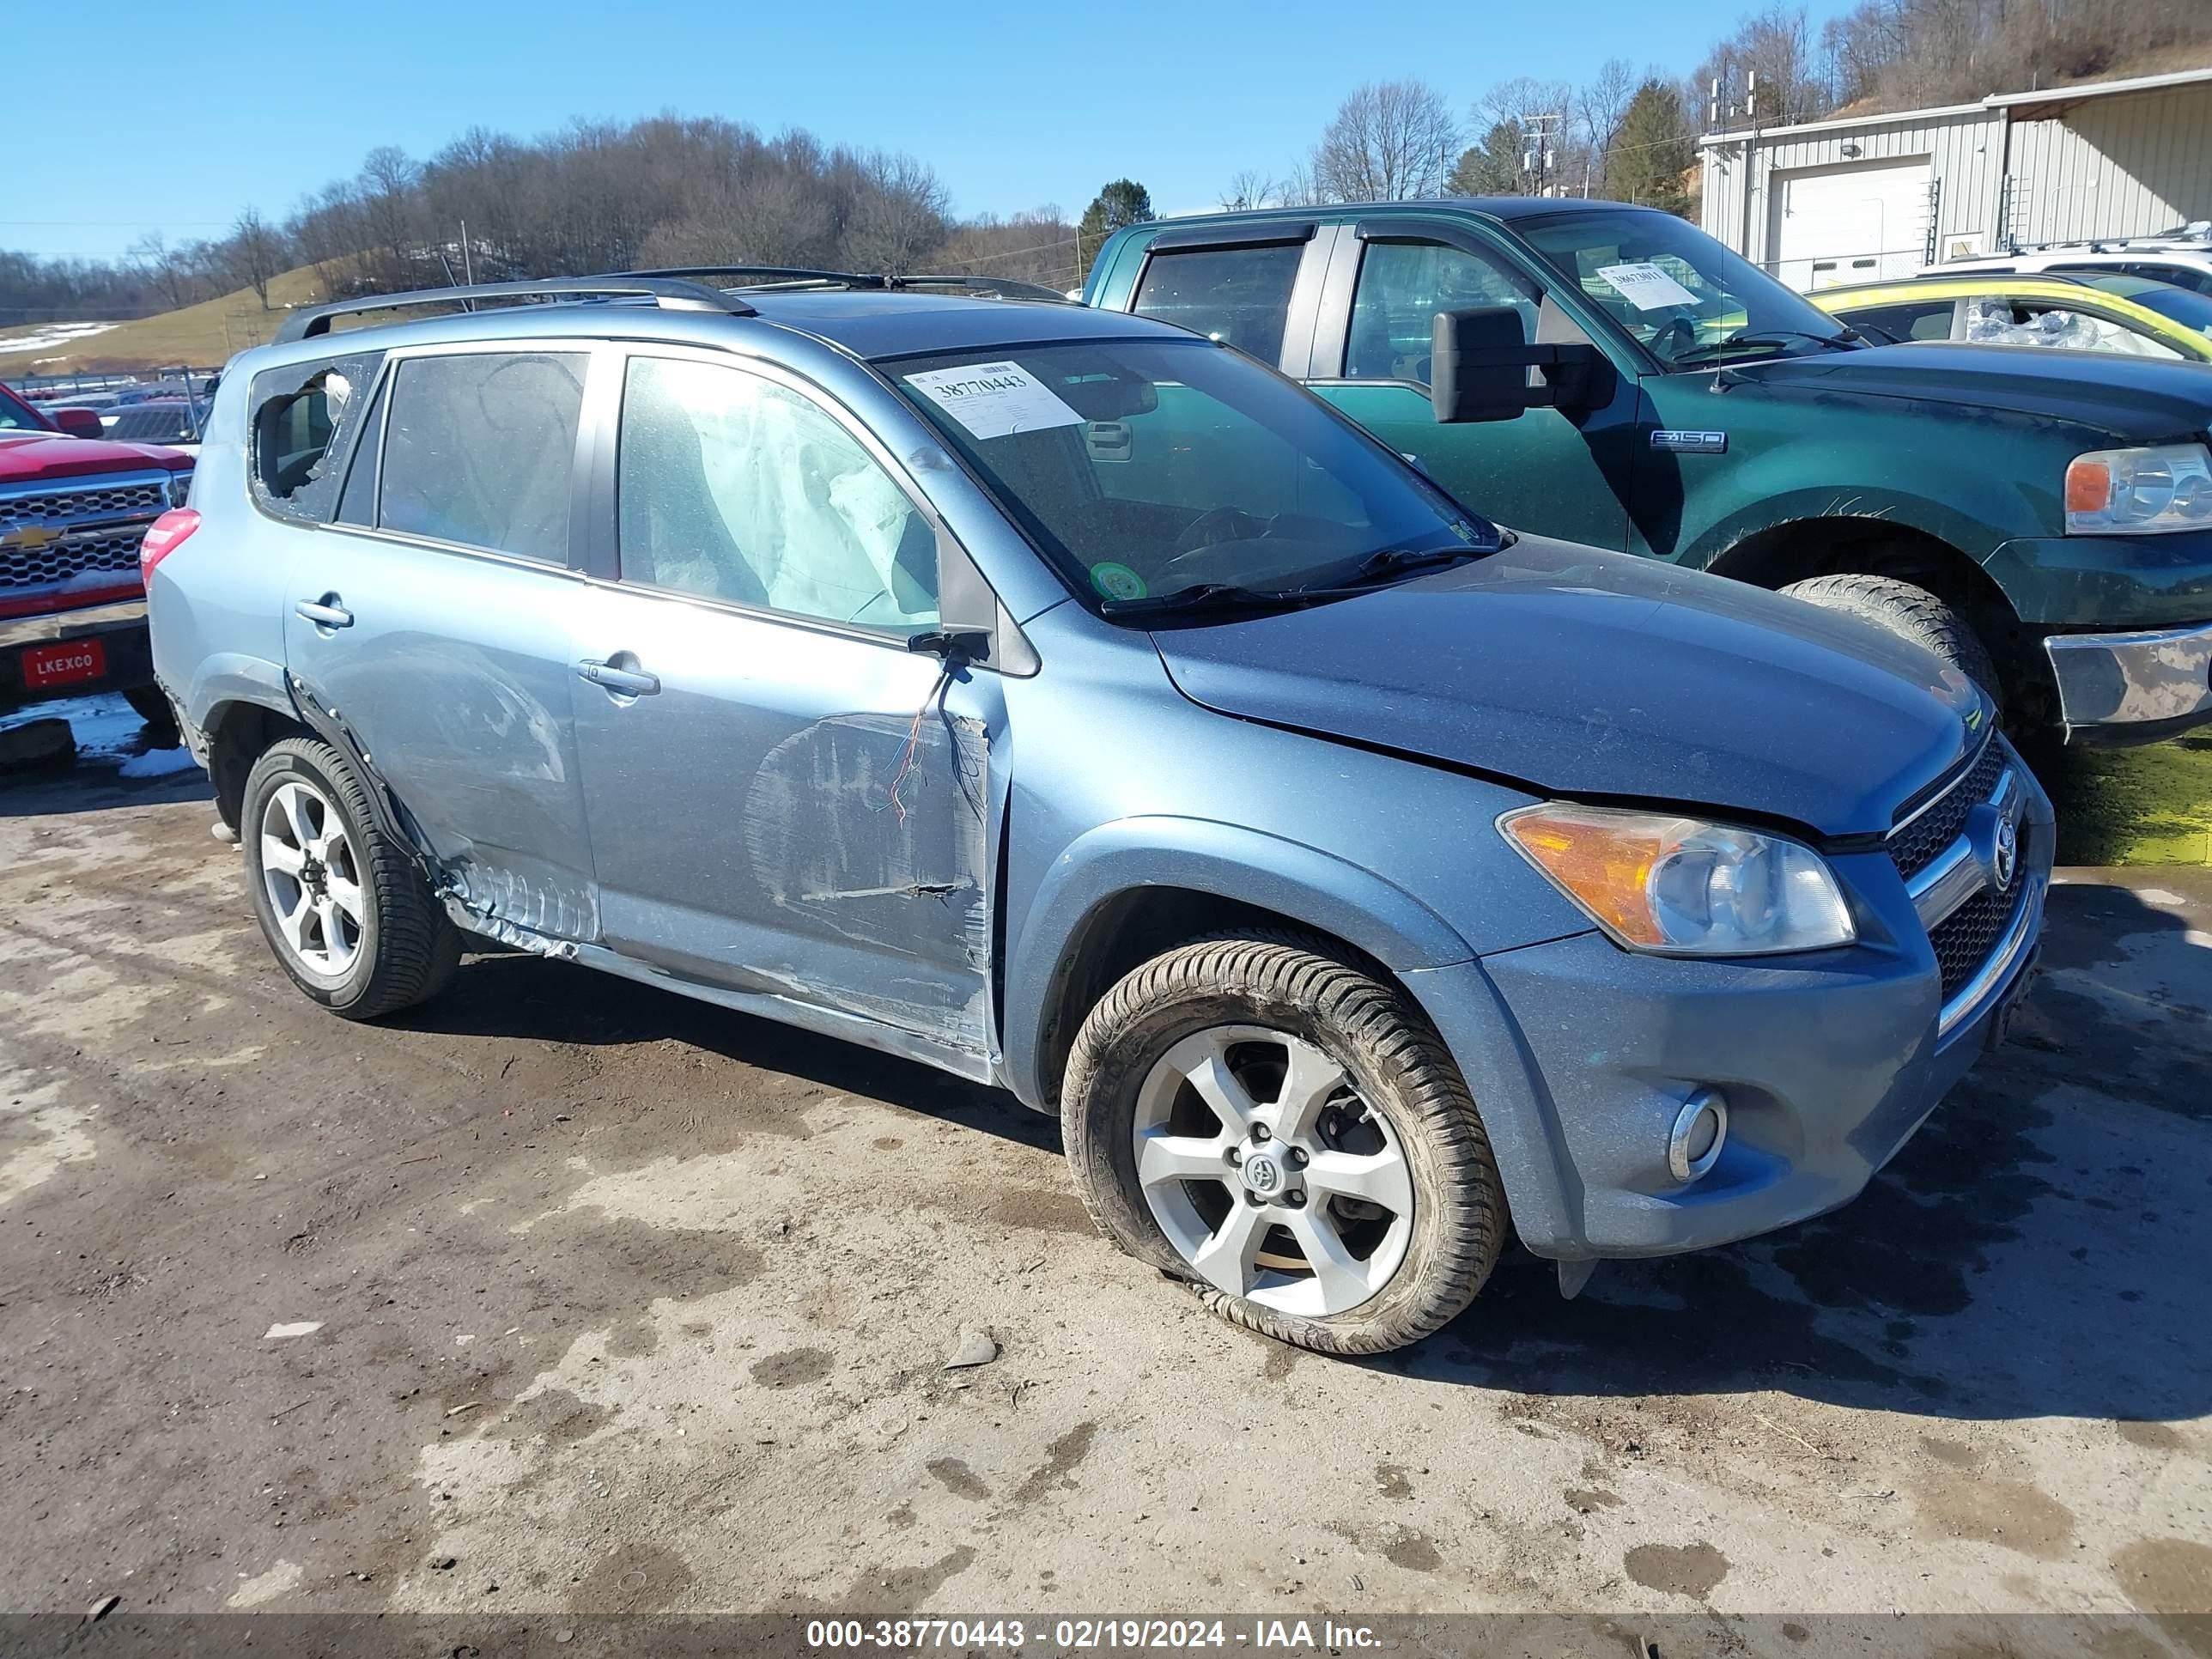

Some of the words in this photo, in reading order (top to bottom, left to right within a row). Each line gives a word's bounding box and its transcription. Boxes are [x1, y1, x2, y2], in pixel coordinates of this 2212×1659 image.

[1613, 271, 1662, 285] 38673011
[934, 375, 1028, 398] 38770443
[36, 654, 94, 675] LKEXCO
